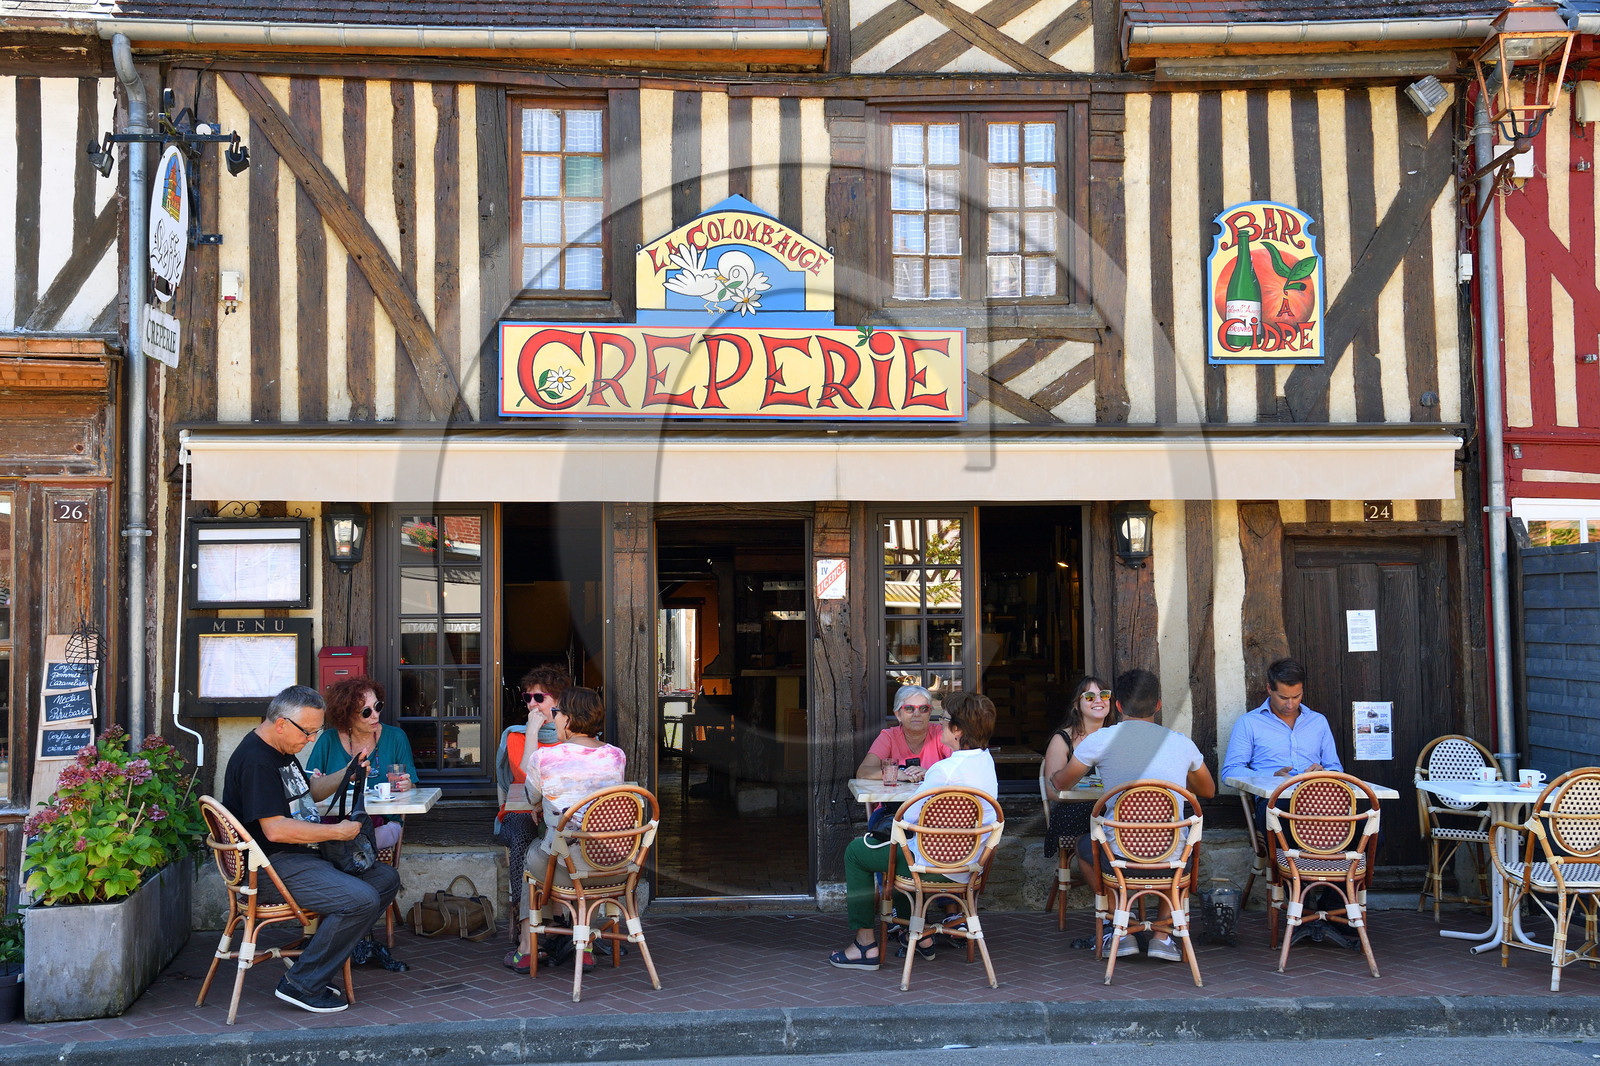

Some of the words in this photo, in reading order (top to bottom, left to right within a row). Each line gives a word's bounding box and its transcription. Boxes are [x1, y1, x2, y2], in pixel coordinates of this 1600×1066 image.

[1220, 208, 1306, 251] BAR
[150, 219, 182, 281] Leffe
[645, 238, 685, 277] LA
[146, 319, 177, 354] CREPERIE
[60, 505, 83, 520] 26
[1370, 505, 1390, 519] 24
[818, 561, 847, 595] LICENCE
[821, 567, 829, 576] IV
[212, 620, 284, 632] MENU
